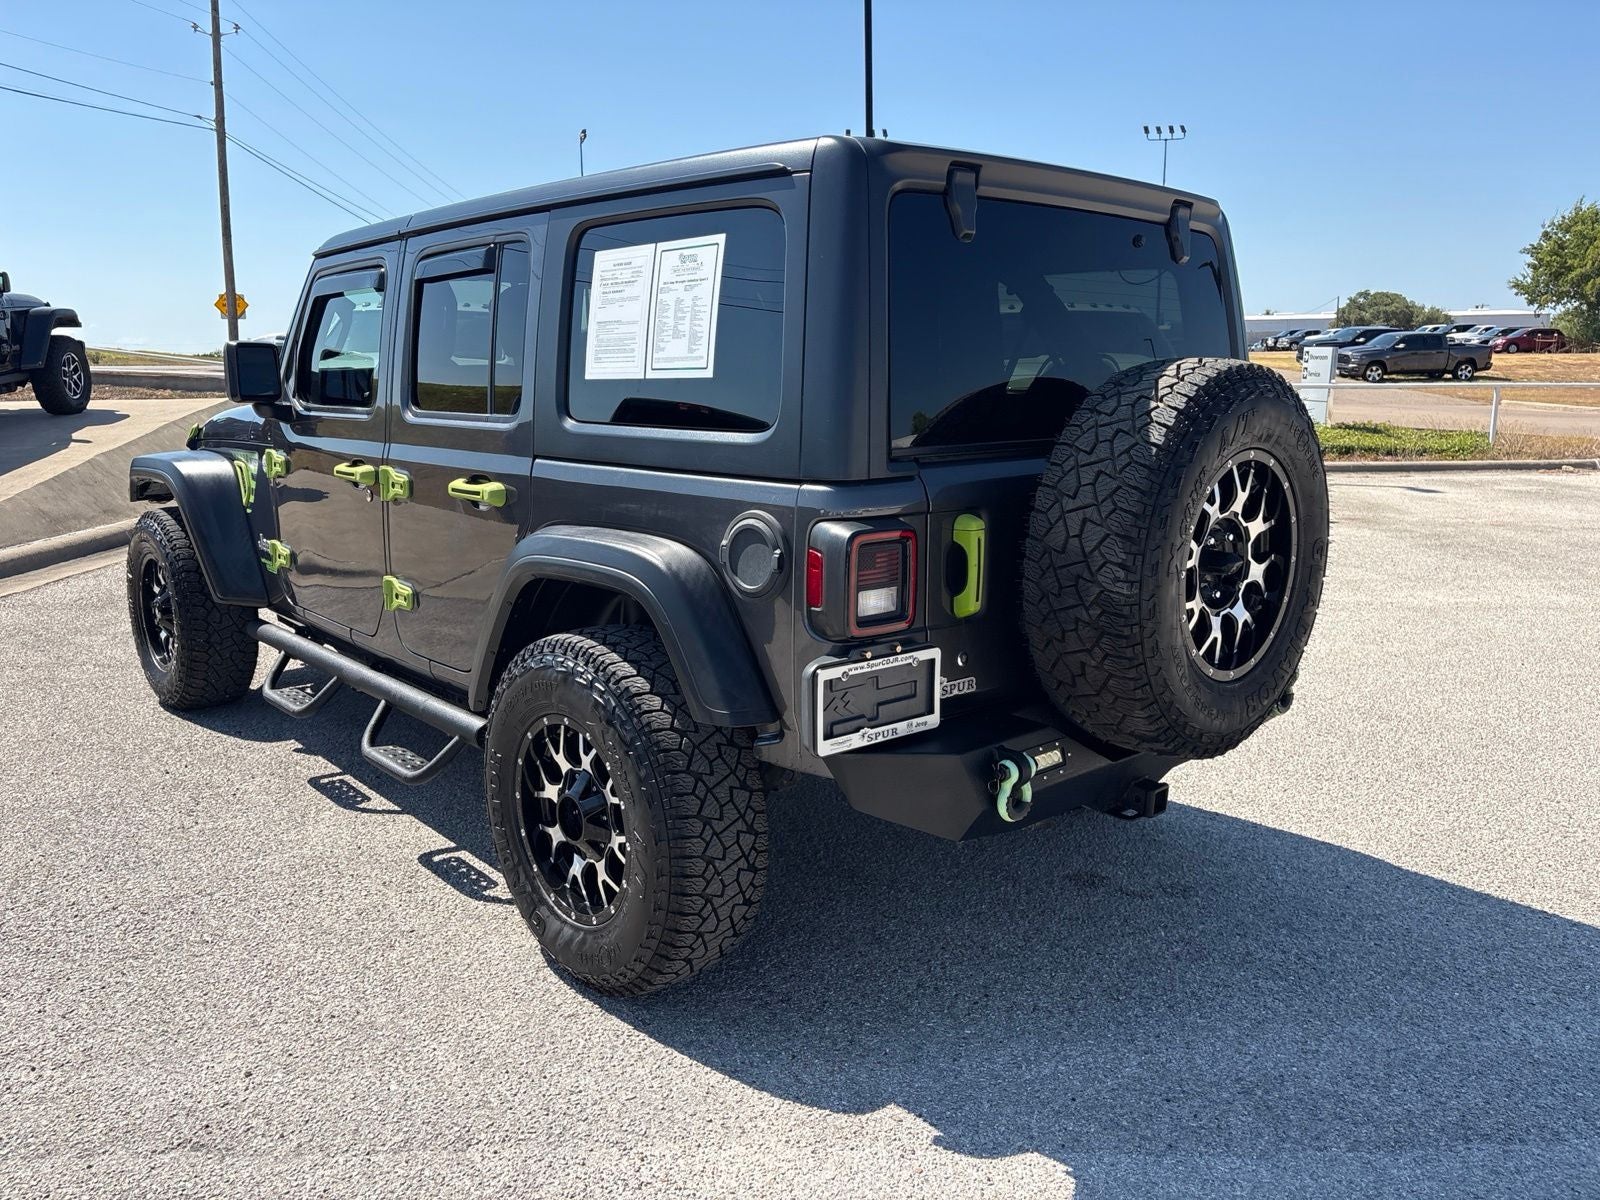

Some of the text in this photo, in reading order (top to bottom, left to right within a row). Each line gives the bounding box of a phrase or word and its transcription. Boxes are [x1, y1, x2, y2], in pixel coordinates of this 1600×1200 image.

[1309, 353, 1329, 361] Showroom
[941, 678, 975, 698] SPUR
[867, 727, 898, 743] SPUR
